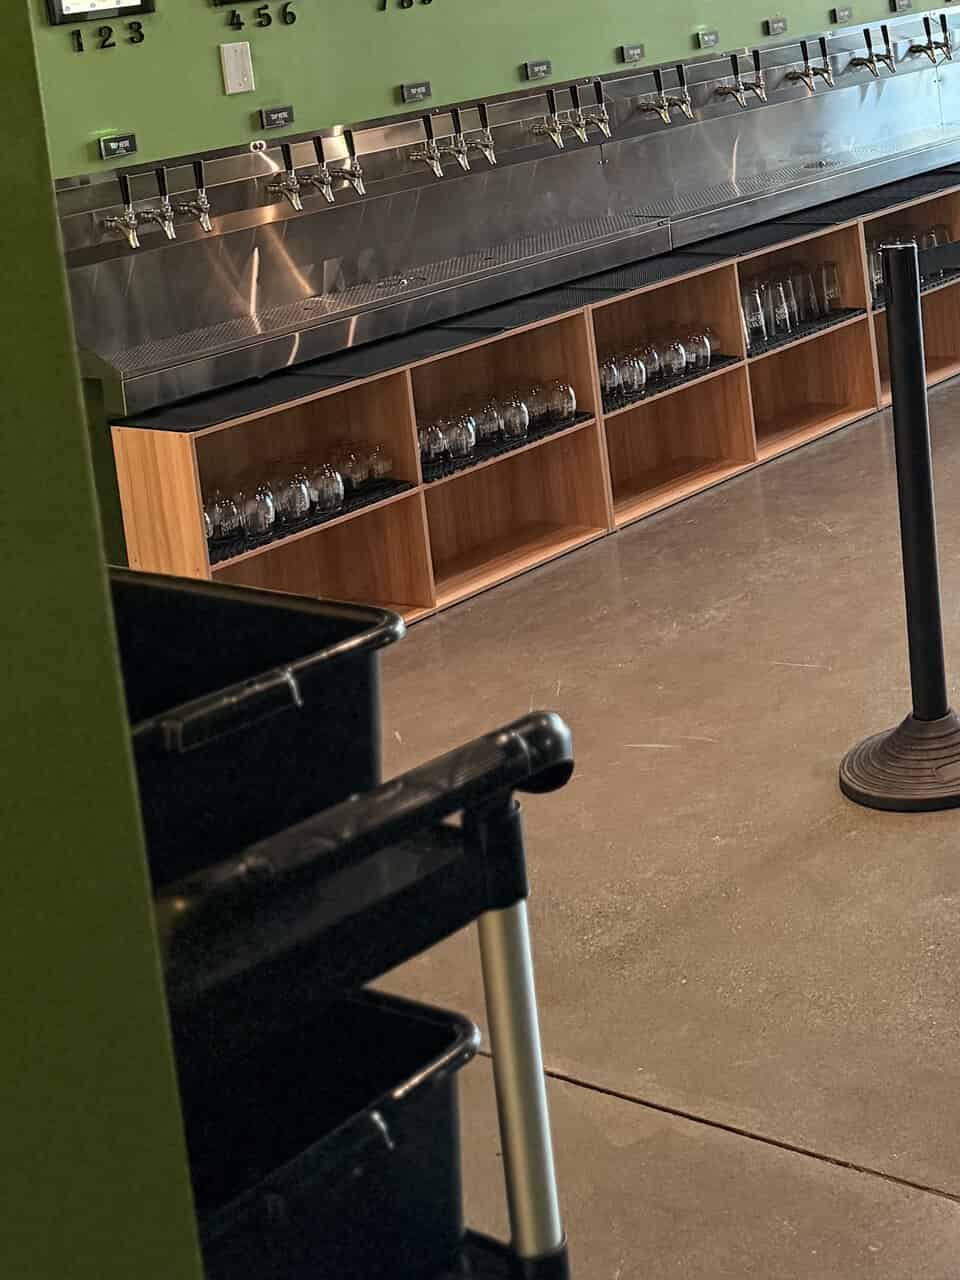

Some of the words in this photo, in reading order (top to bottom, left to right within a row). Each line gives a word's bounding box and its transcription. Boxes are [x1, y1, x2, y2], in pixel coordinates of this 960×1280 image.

[228, 9, 245, 30] 4
[255, 4, 272, 27] 5
[282, 2, 297, 25] 6
[71, 29, 84, 52] 1
[98, 26, 116, 49] 2
[128, 22, 145, 44] 3
